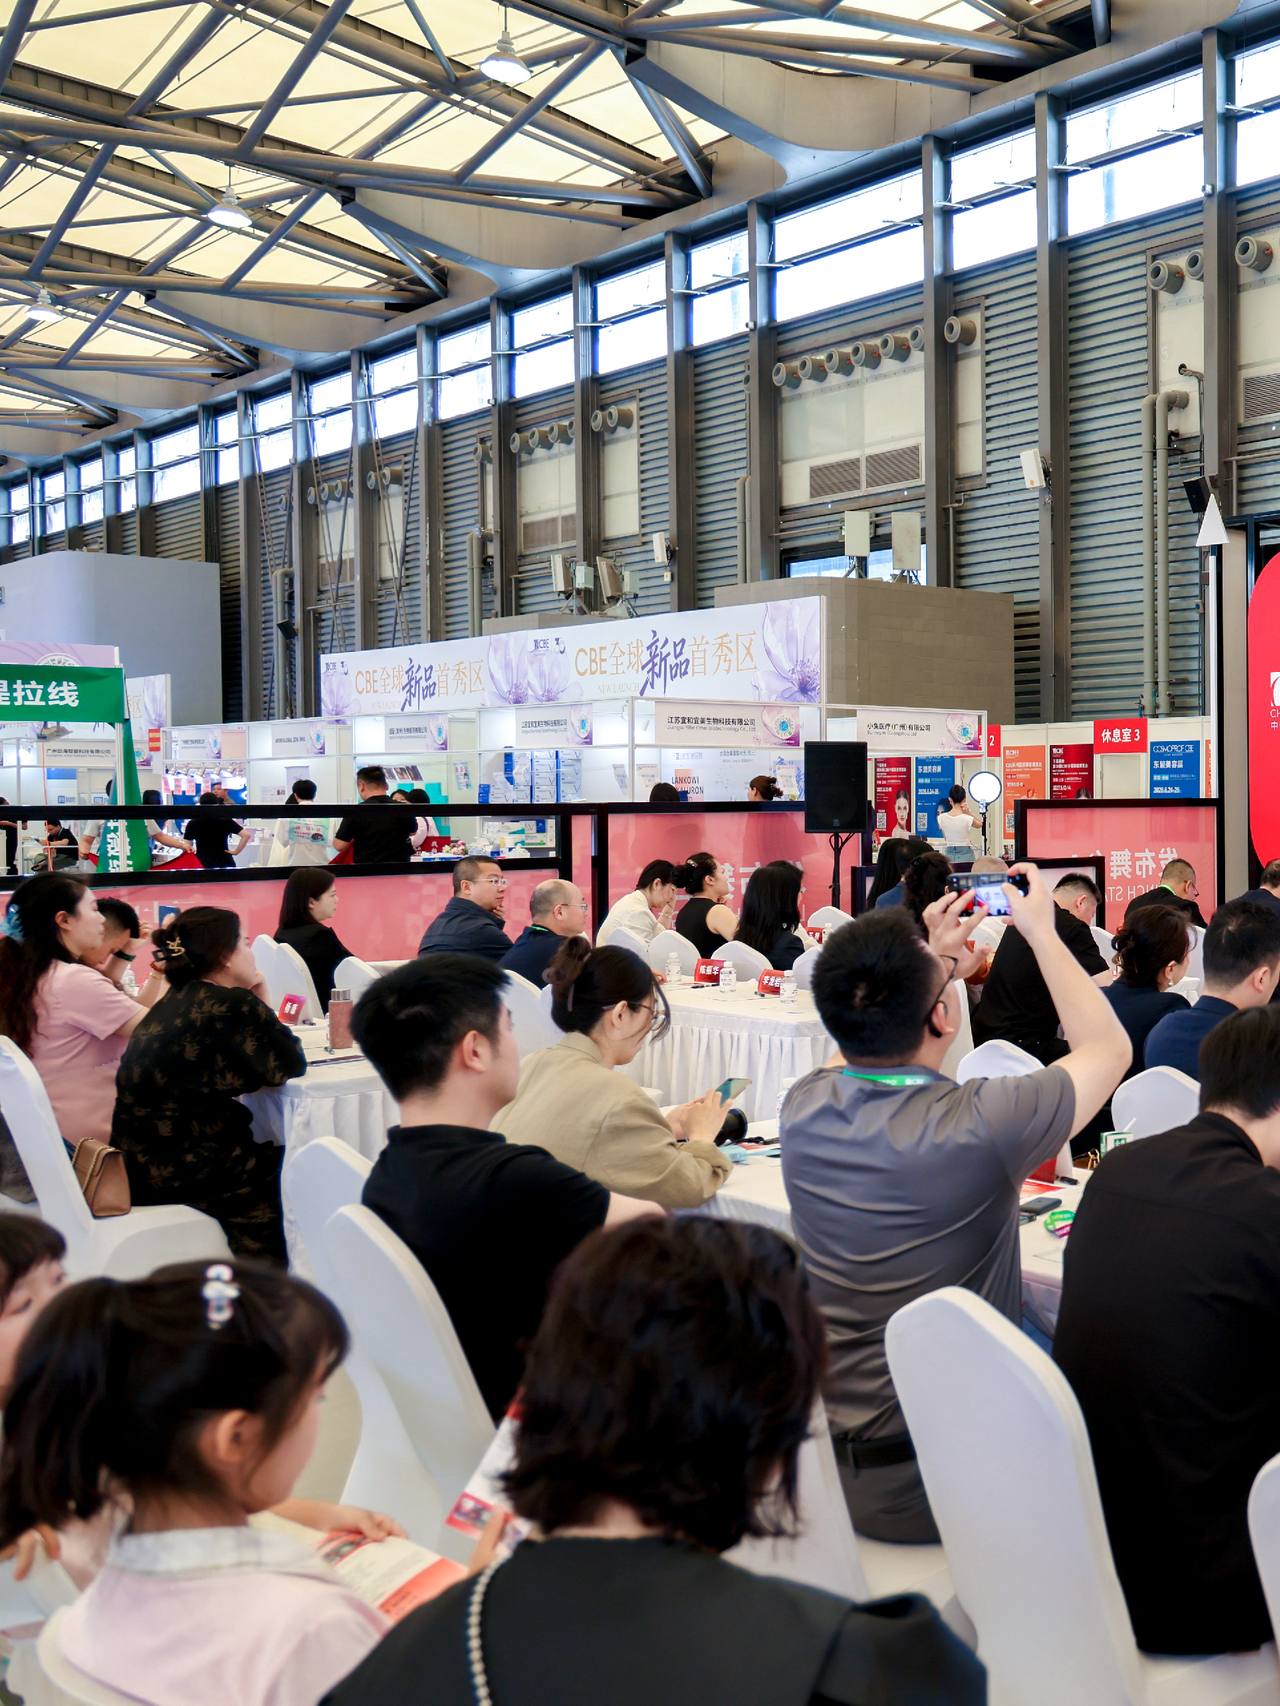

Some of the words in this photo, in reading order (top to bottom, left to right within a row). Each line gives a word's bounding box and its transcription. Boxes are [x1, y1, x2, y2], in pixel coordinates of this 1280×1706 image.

[574, 629, 759, 697] CBE全球新品首秀区
[989, 735, 995, 746] 2
[1101, 728, 1132, 743] 休息室
[1134, 729, 1141, 742] 3
